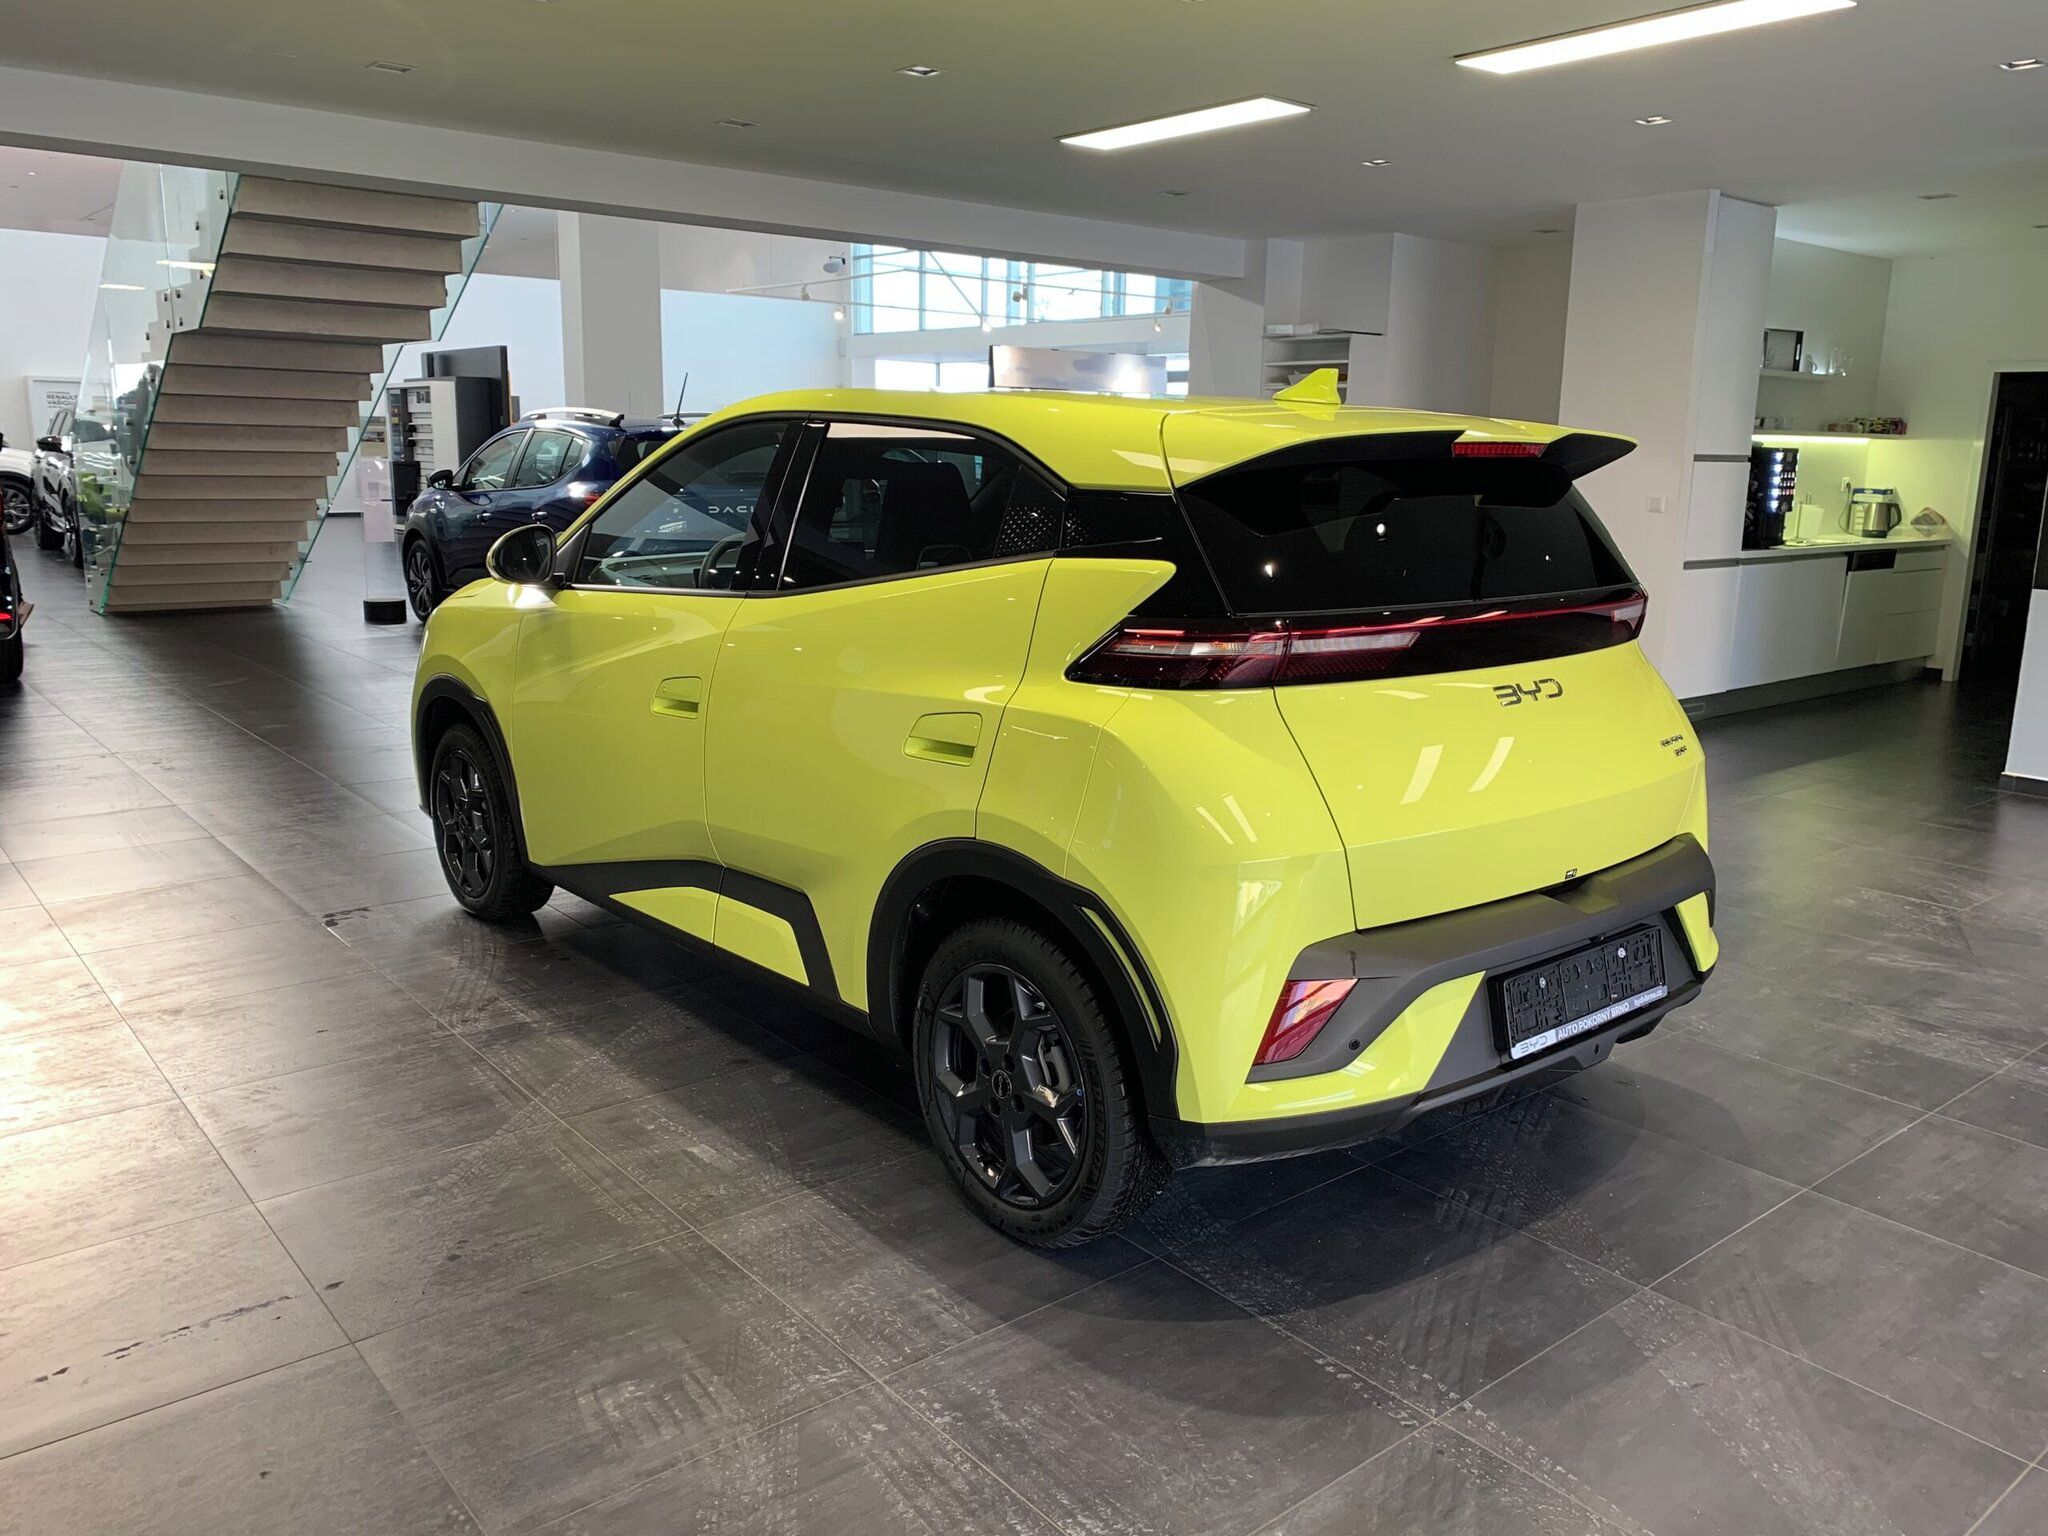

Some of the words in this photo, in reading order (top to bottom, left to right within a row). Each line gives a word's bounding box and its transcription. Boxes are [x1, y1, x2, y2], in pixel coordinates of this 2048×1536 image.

[1493, 678, 1563, 707] BYD
[1520, 1035, 1548, 1054] BYD
[1558, 1023, 1578, 1040] AUTO
[1578, 1006, 1611, 1031] POKORNÝ
[1611, 1002, 1630, 1017] BRNO
